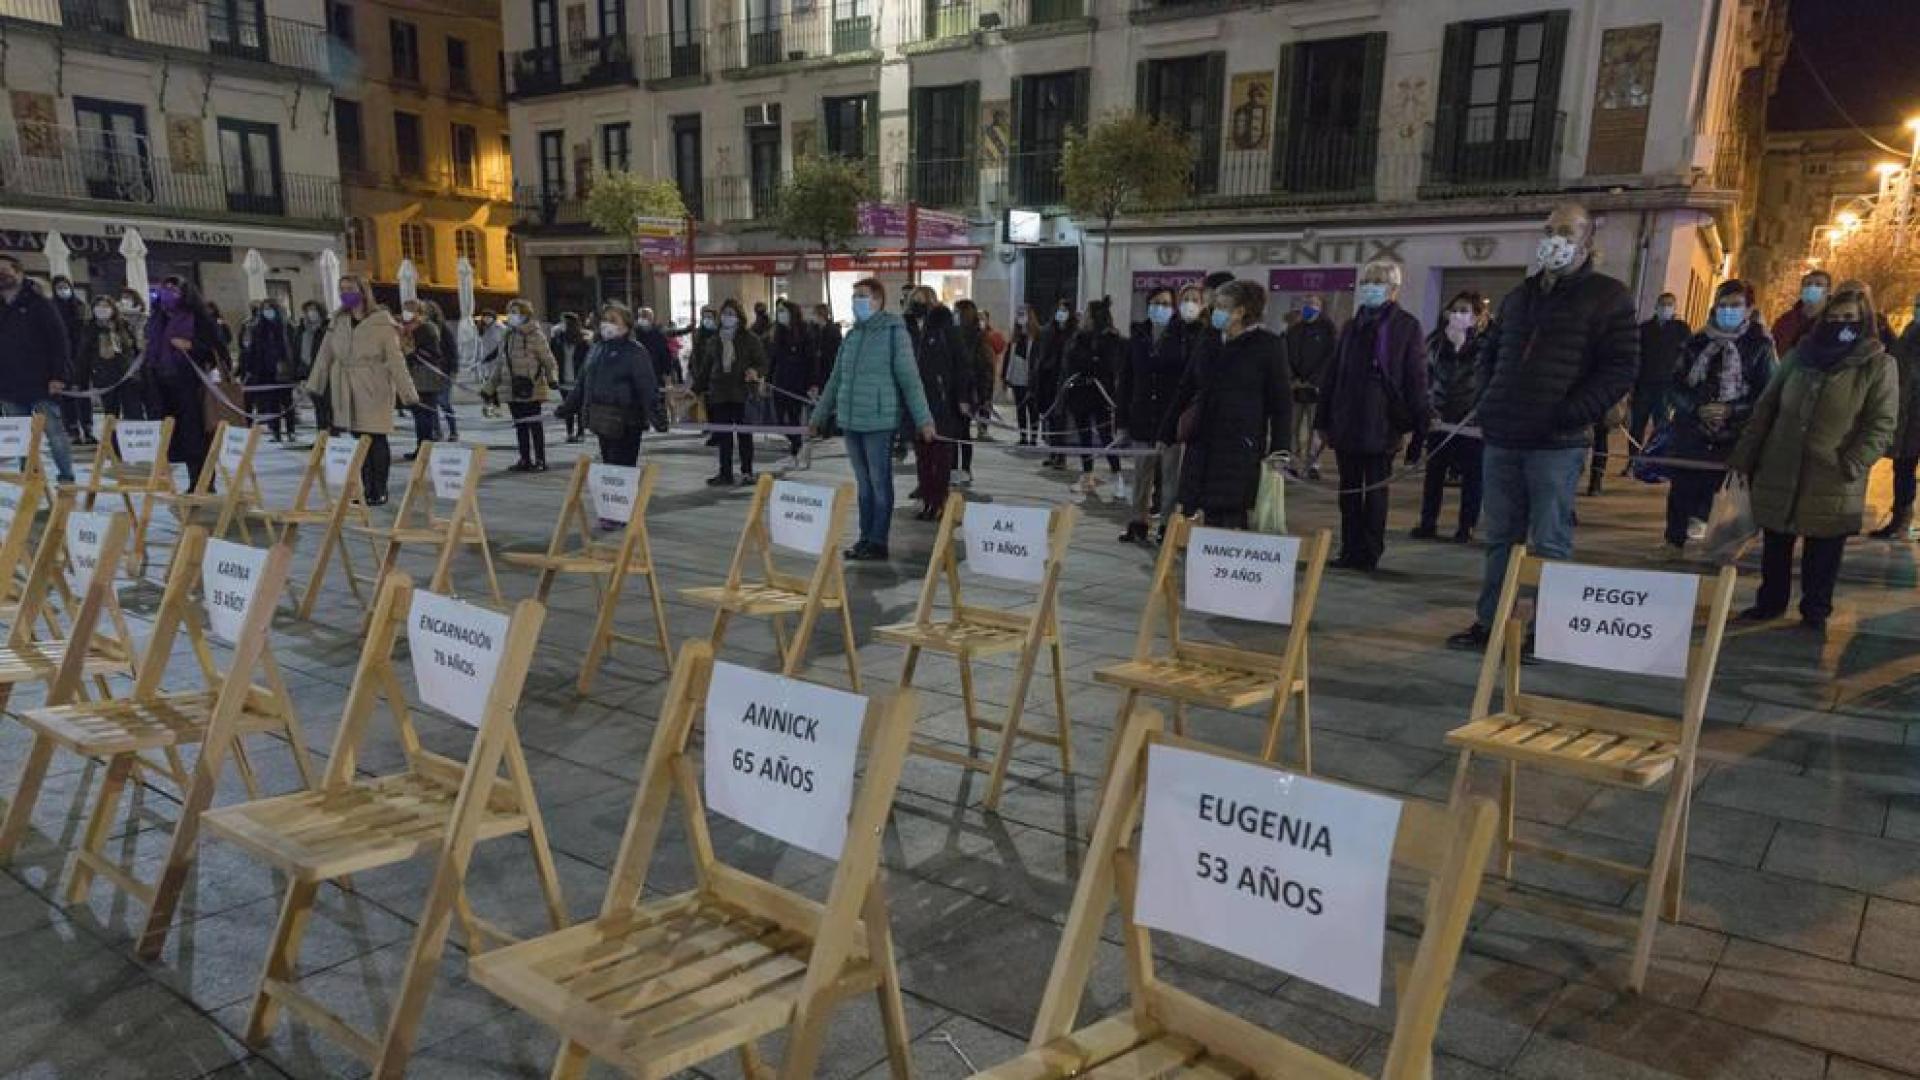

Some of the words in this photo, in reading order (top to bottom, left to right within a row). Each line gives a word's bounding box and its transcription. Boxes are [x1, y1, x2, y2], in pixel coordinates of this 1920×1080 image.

[165, 228, 234, 244] ARAGON
[1229, 239, 1404, 265] DENTIX
[997, 541, 1028, 557] AÑOS
[1202, 544, 1242, 559] NANCY
[1244, 548, 1281, 562] PAOLA
[216, 559, 250, 580] KARINA
[1214, 567, 1228, 579] 29
[1231, 568, 1262, 583] AÑOS
[224, 591, 245, 612] AÑOS
[1582, 586, 1649, 606] PEGGY
[419, 613, 492, 651] ENCARNACIÓN
[1568, 614, 1591, 633] 49
[1595, 617, 1654, 640] AÑOS
[446, 652, 477, 677] AÑOS
[741, 700, 819, 743] ANNICK
[732, 748, 755, 774] 65
[759, 754, 815, 793] AÑOS
[1198, 793, 1333, 857] EUGENIA
[1196, 851, 1229, 885] 53
[1236, 865, 1323, 916] AÑOS
